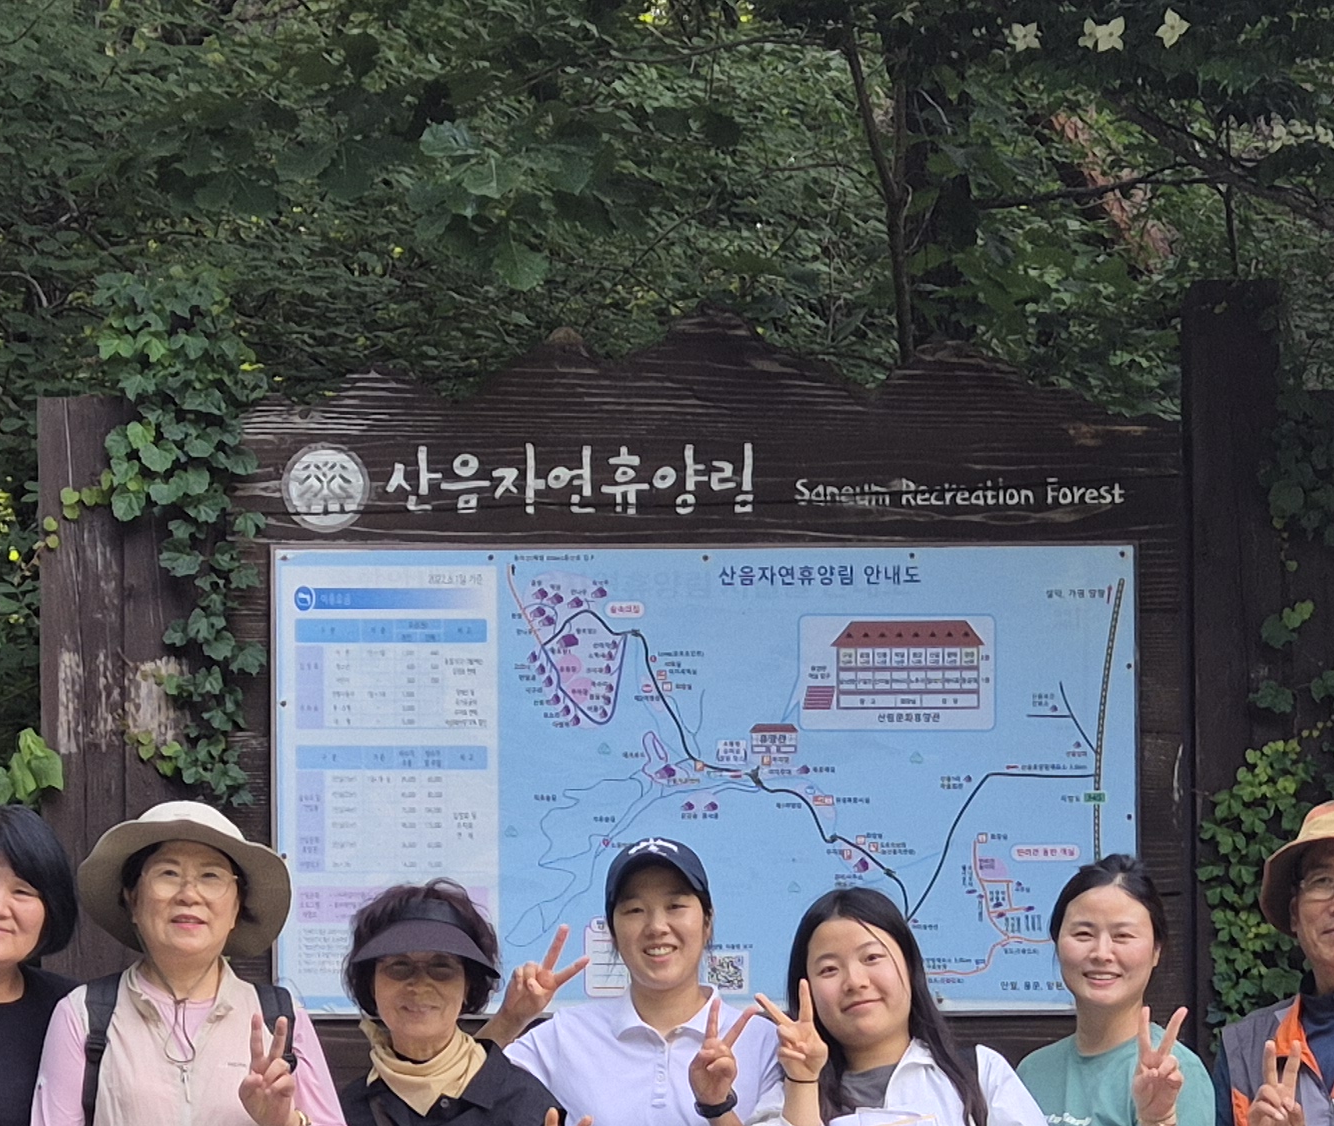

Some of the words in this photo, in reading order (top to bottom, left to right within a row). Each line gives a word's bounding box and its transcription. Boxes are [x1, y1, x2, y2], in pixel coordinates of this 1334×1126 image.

[385, 443, 755, 514] 산음자연휴양림
[900, 477, 1034, 506] Recreation
[1046, 477, 1125, 505] Forest
[719, 566, 855, 587] 산음자연휴양림
[863, 565, 922, 585] 안내도
